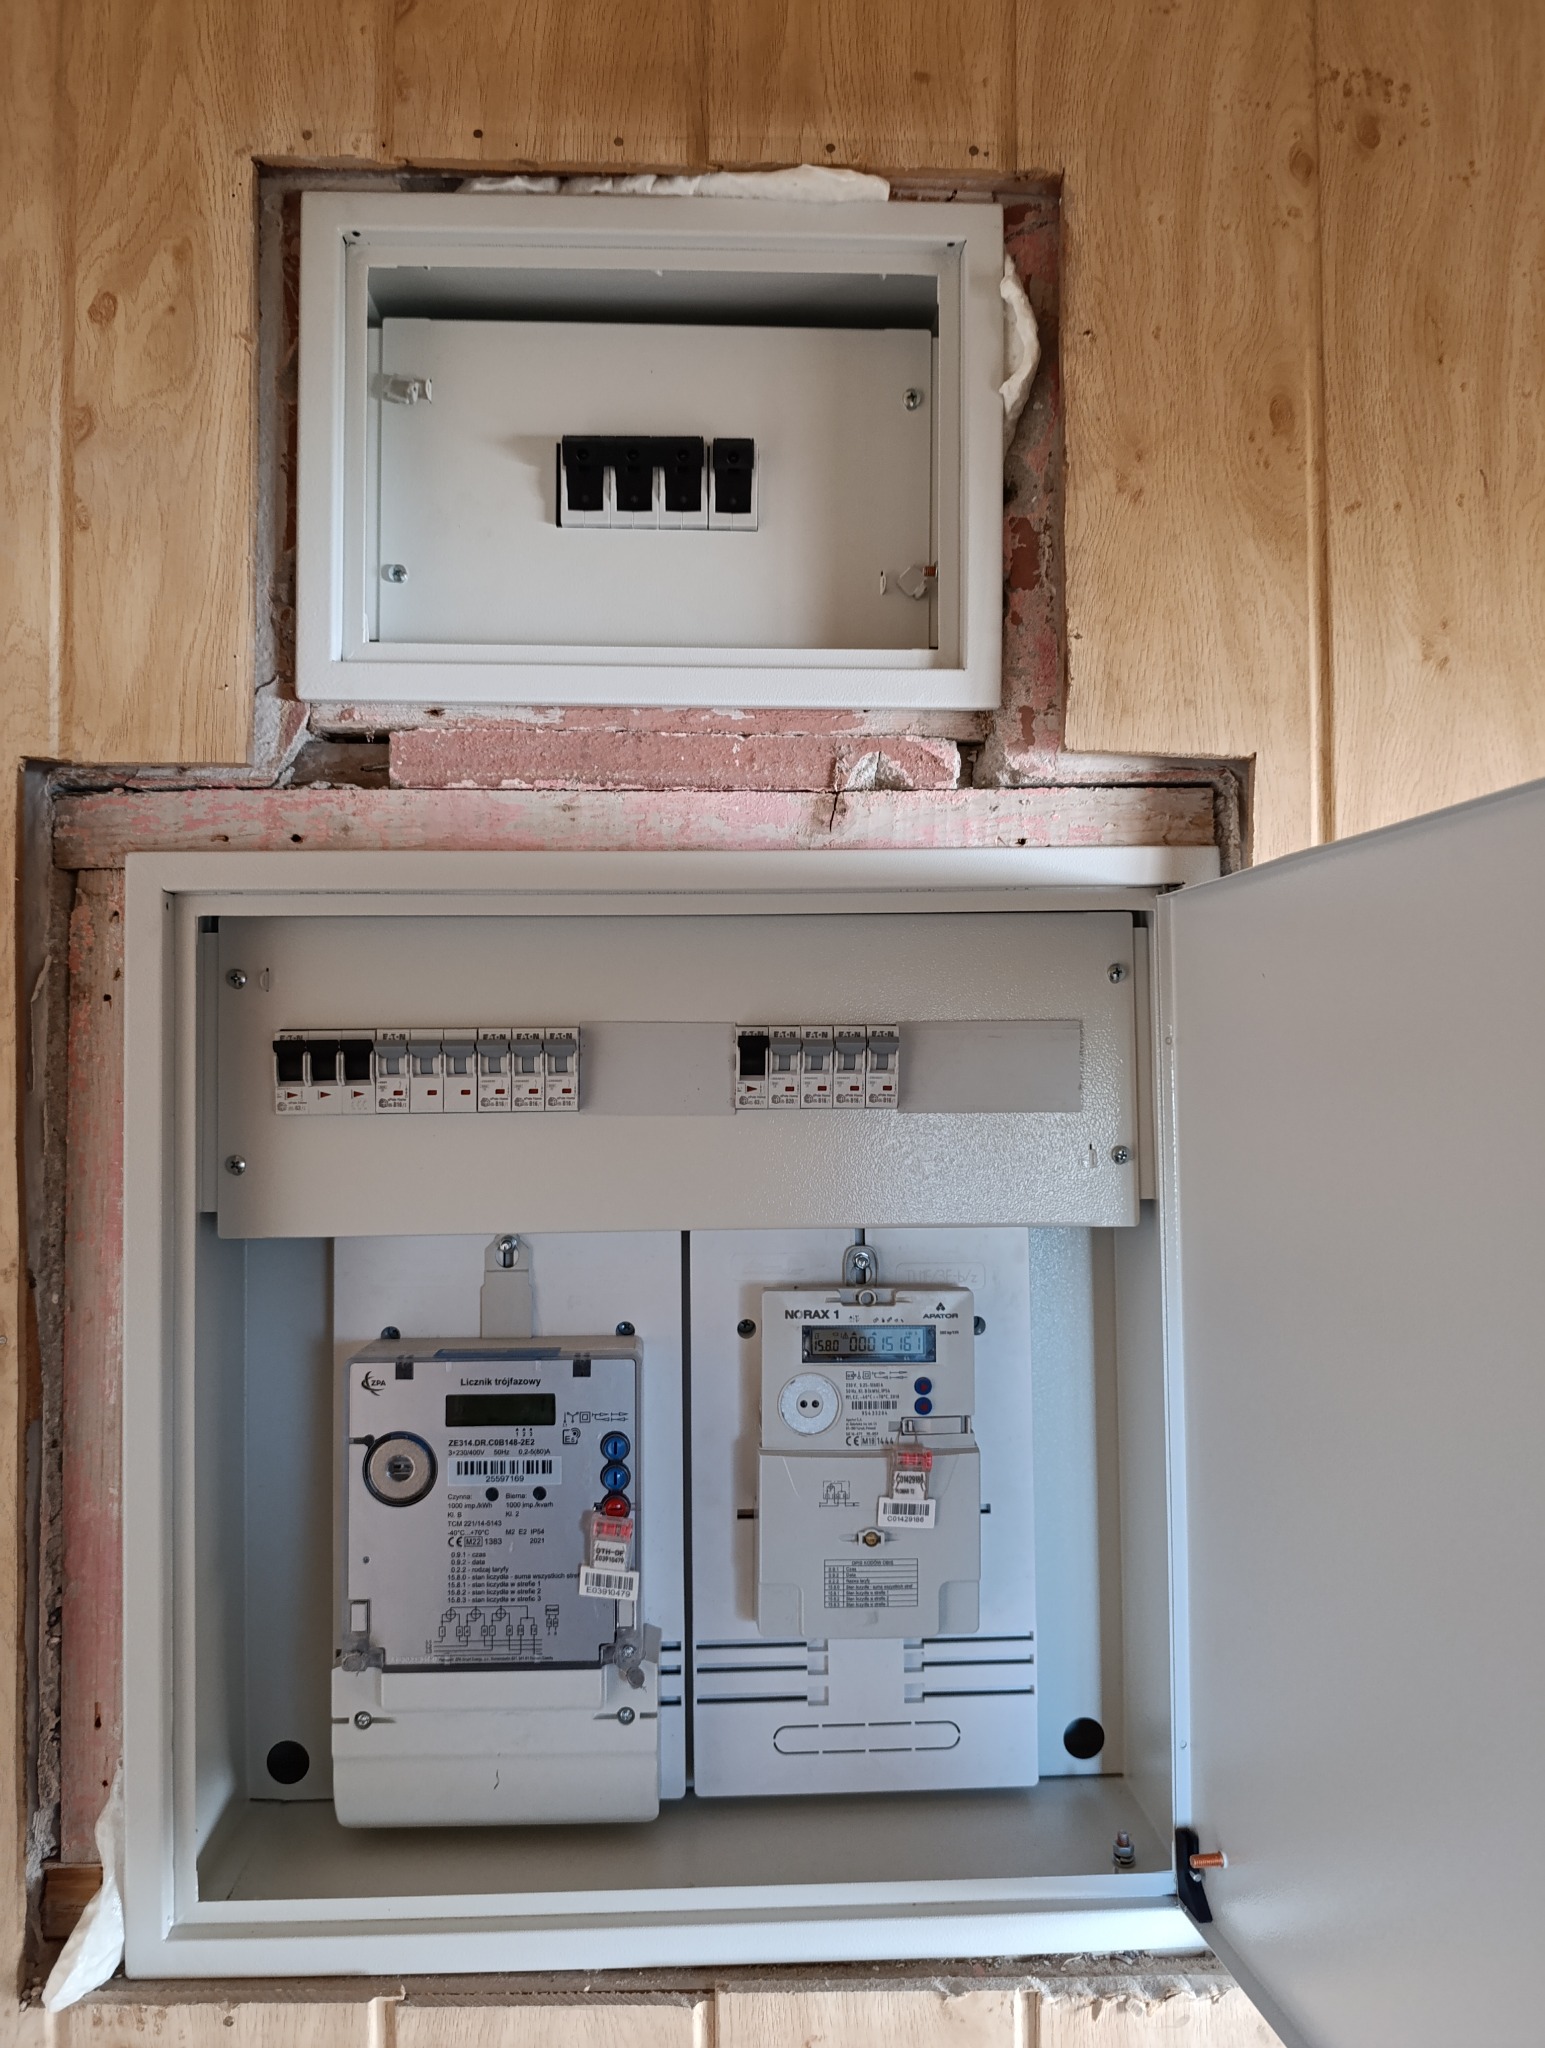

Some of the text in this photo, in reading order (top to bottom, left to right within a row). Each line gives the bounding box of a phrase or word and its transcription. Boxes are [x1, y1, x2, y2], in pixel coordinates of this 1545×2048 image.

[833, 1310, 840, 1320] 1
[460, 1377, 542, 1388] Licznik trójfazowy
[464, 1538, 482, 1546] M22
[586, 1586, 631, 1598] E03910479
